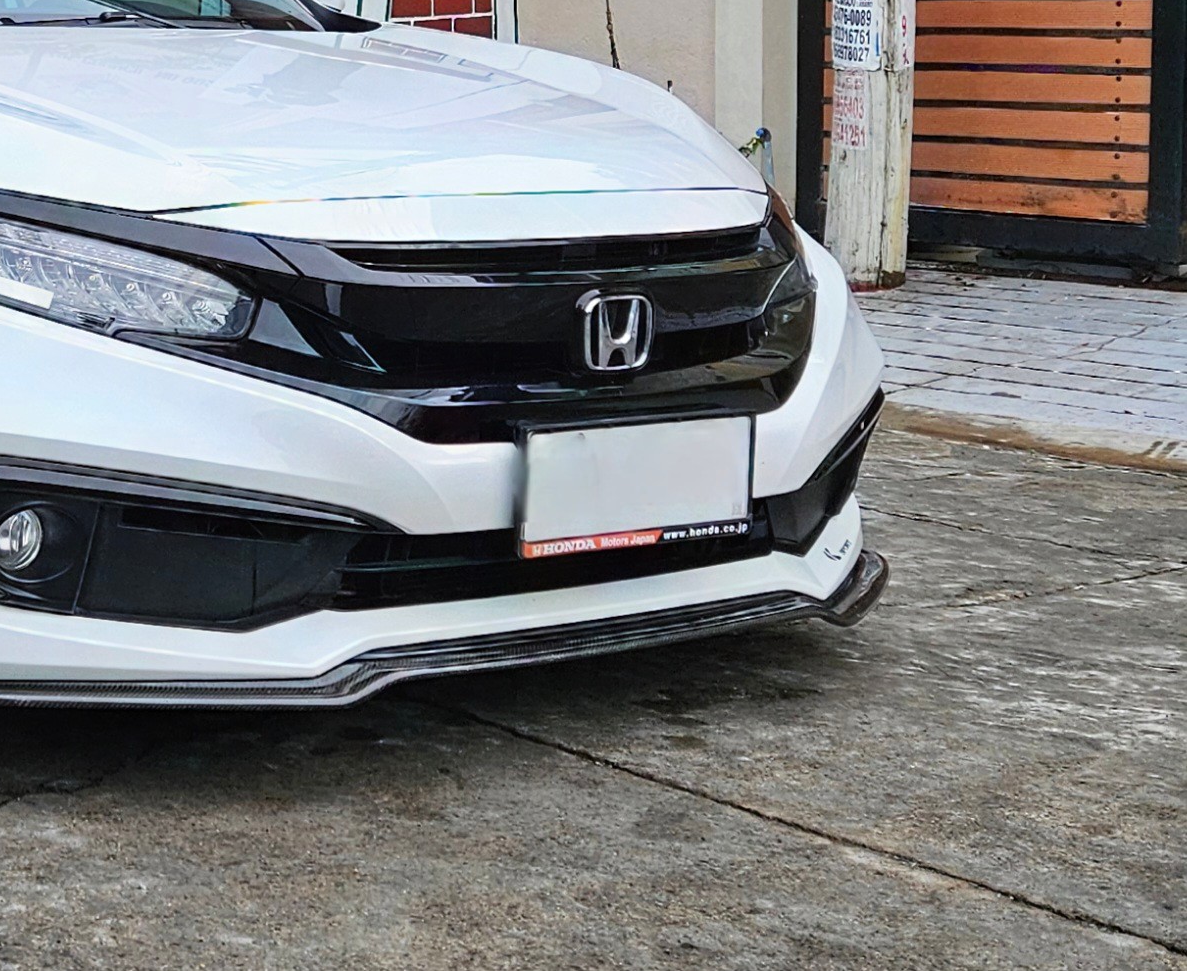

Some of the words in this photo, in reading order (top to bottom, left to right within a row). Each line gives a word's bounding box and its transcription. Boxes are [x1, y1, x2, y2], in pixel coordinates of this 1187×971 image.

[662, 522, 749, 541] www.honda.co.jp
[541, 539, 597, 556] HONDA
[600, 536, 629, 548] Motors
[630, 533, 656, 548] Japan
